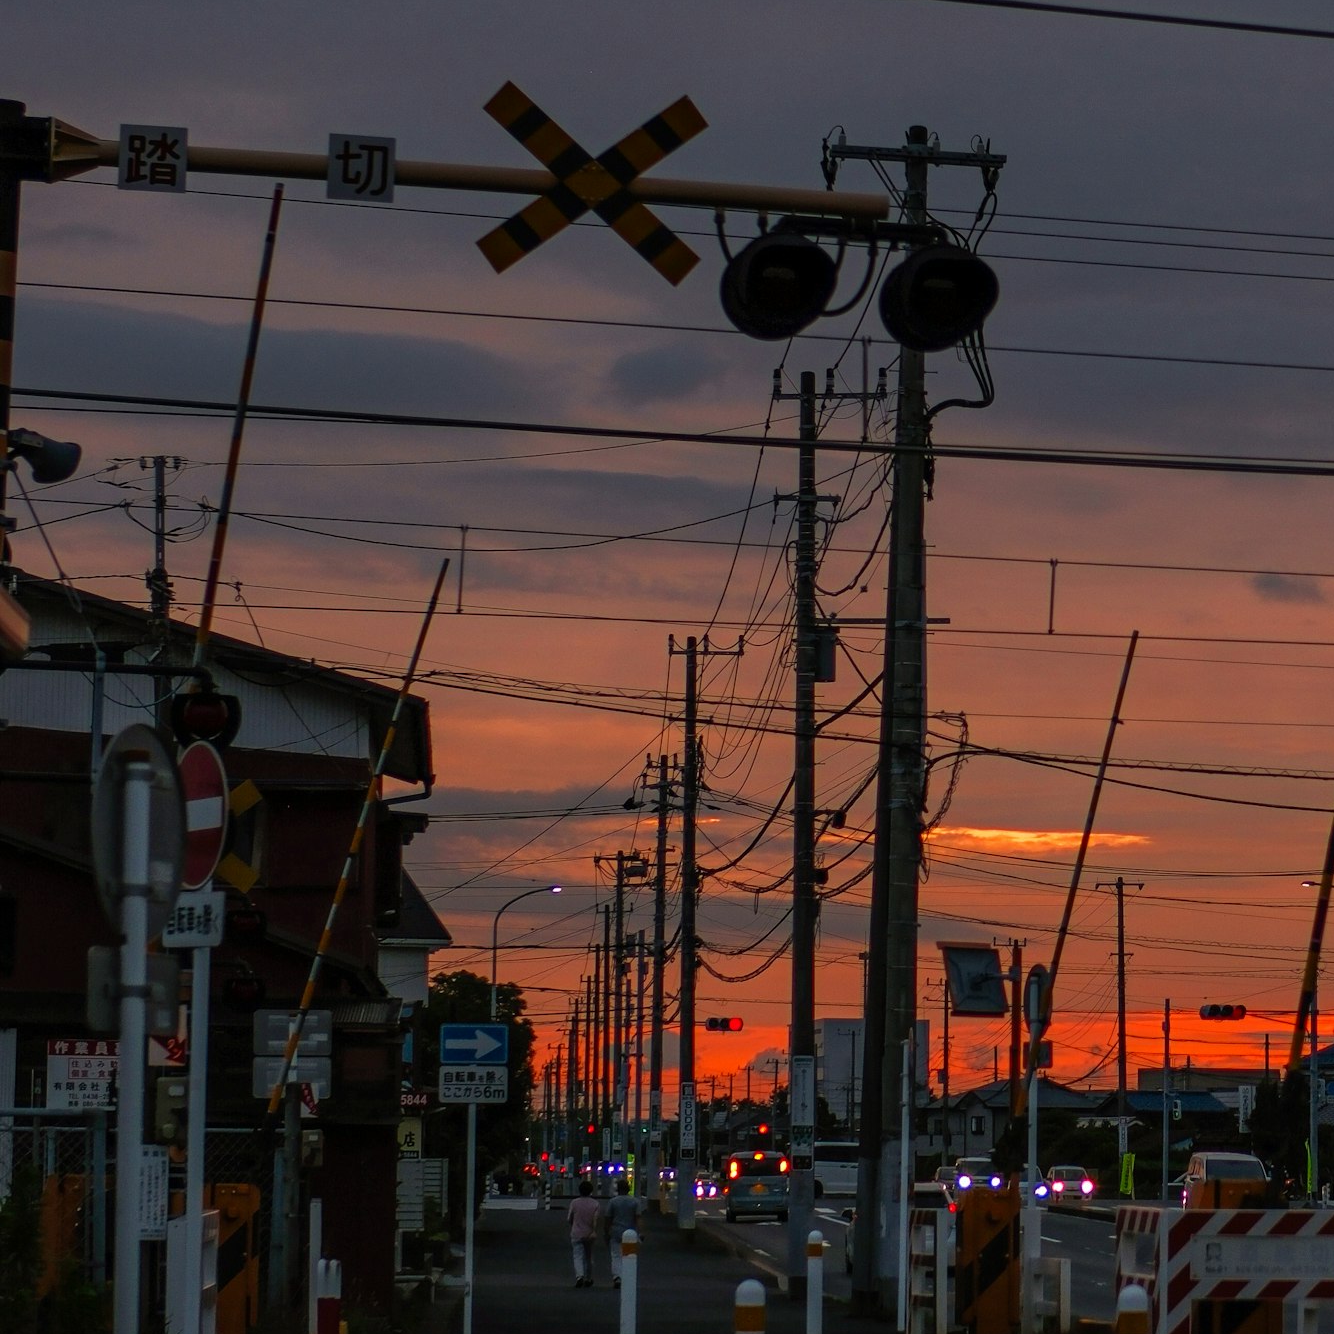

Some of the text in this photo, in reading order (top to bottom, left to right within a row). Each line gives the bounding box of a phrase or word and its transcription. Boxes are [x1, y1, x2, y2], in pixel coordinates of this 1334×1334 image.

[125, 133, 388, 196] 踏 切
[443, 1086, 505, 1099] ここから6m
[403, 1132, 415, 1147] 店
